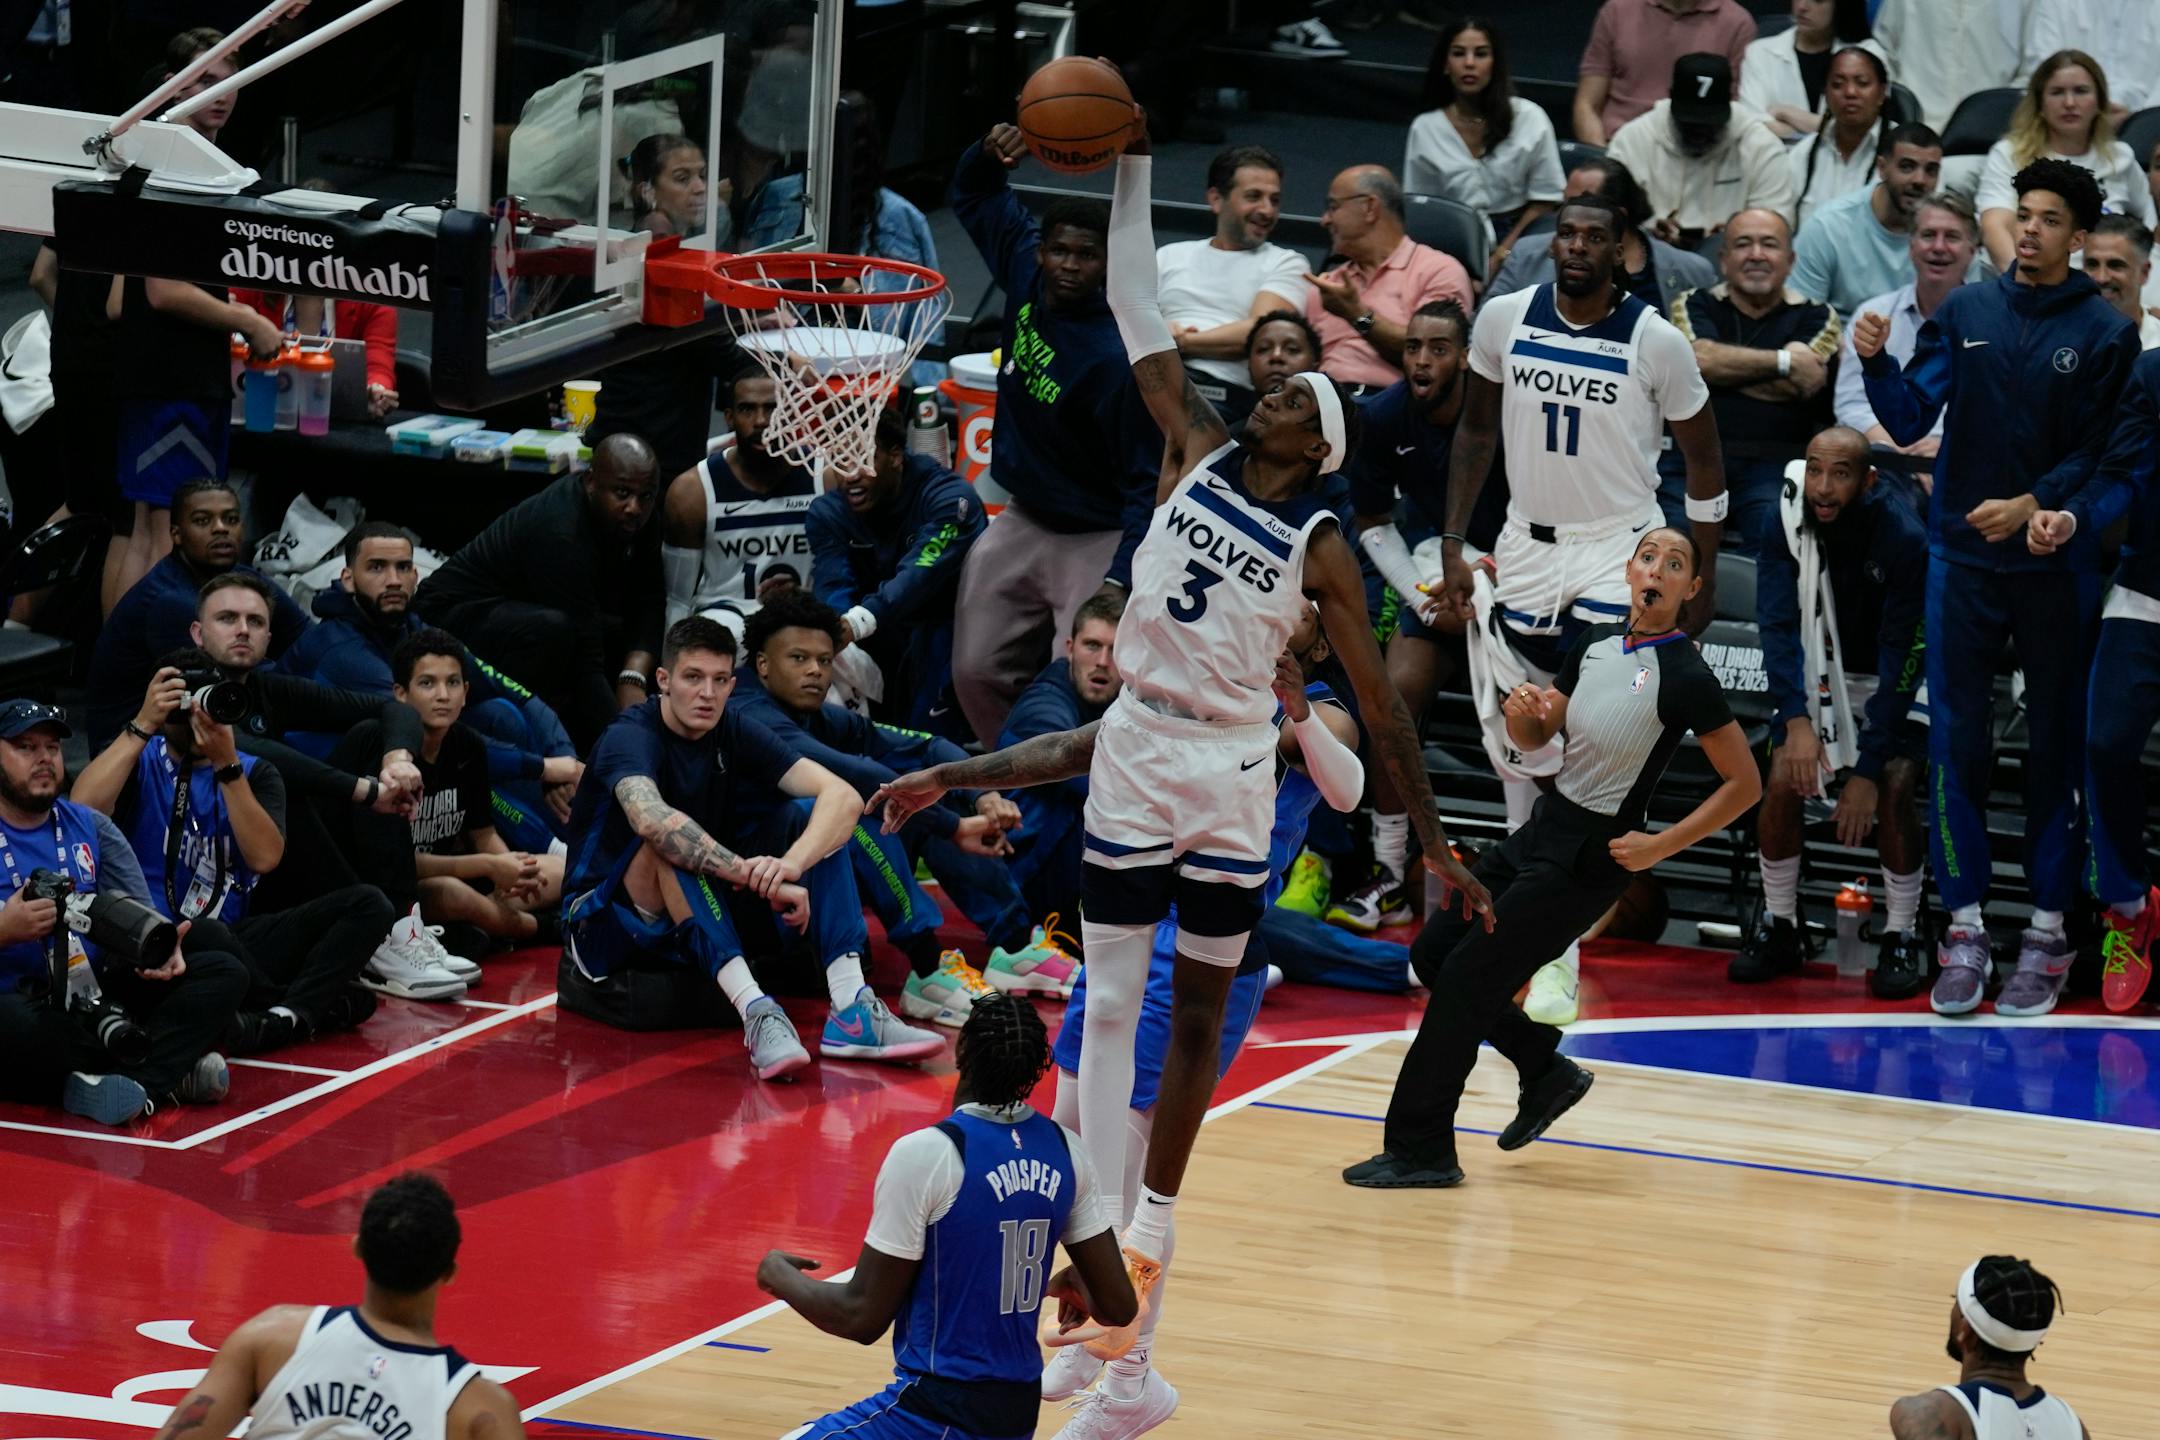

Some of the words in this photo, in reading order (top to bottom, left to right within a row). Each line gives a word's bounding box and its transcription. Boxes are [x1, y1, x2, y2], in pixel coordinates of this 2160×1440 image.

[1696, 75, 1714, 98] 7
[1038, 144, 1116, 166] Wilson
[224, 219, 335, 249] experience
[220, 242, 302, 285] abu
[307, 254, 431, 302] dhabi
[1512, 365, 1619, 405] WOLVES
[1541, 401, 1581, 457] 11
[717, 534, 809, 558] WOLVE
[1166, 505, 1281, 594] WOLVES
[1166, 558, 1225, 623] 3
[1701, 643, 1728, 667] ABU
[1725, 646, 1765, 671] DHABI
[175, 781, 188, 820] SONY
[985, 1158, 1062, 1204] PROSPER
[999, 1218, 1051, 1316] 18
